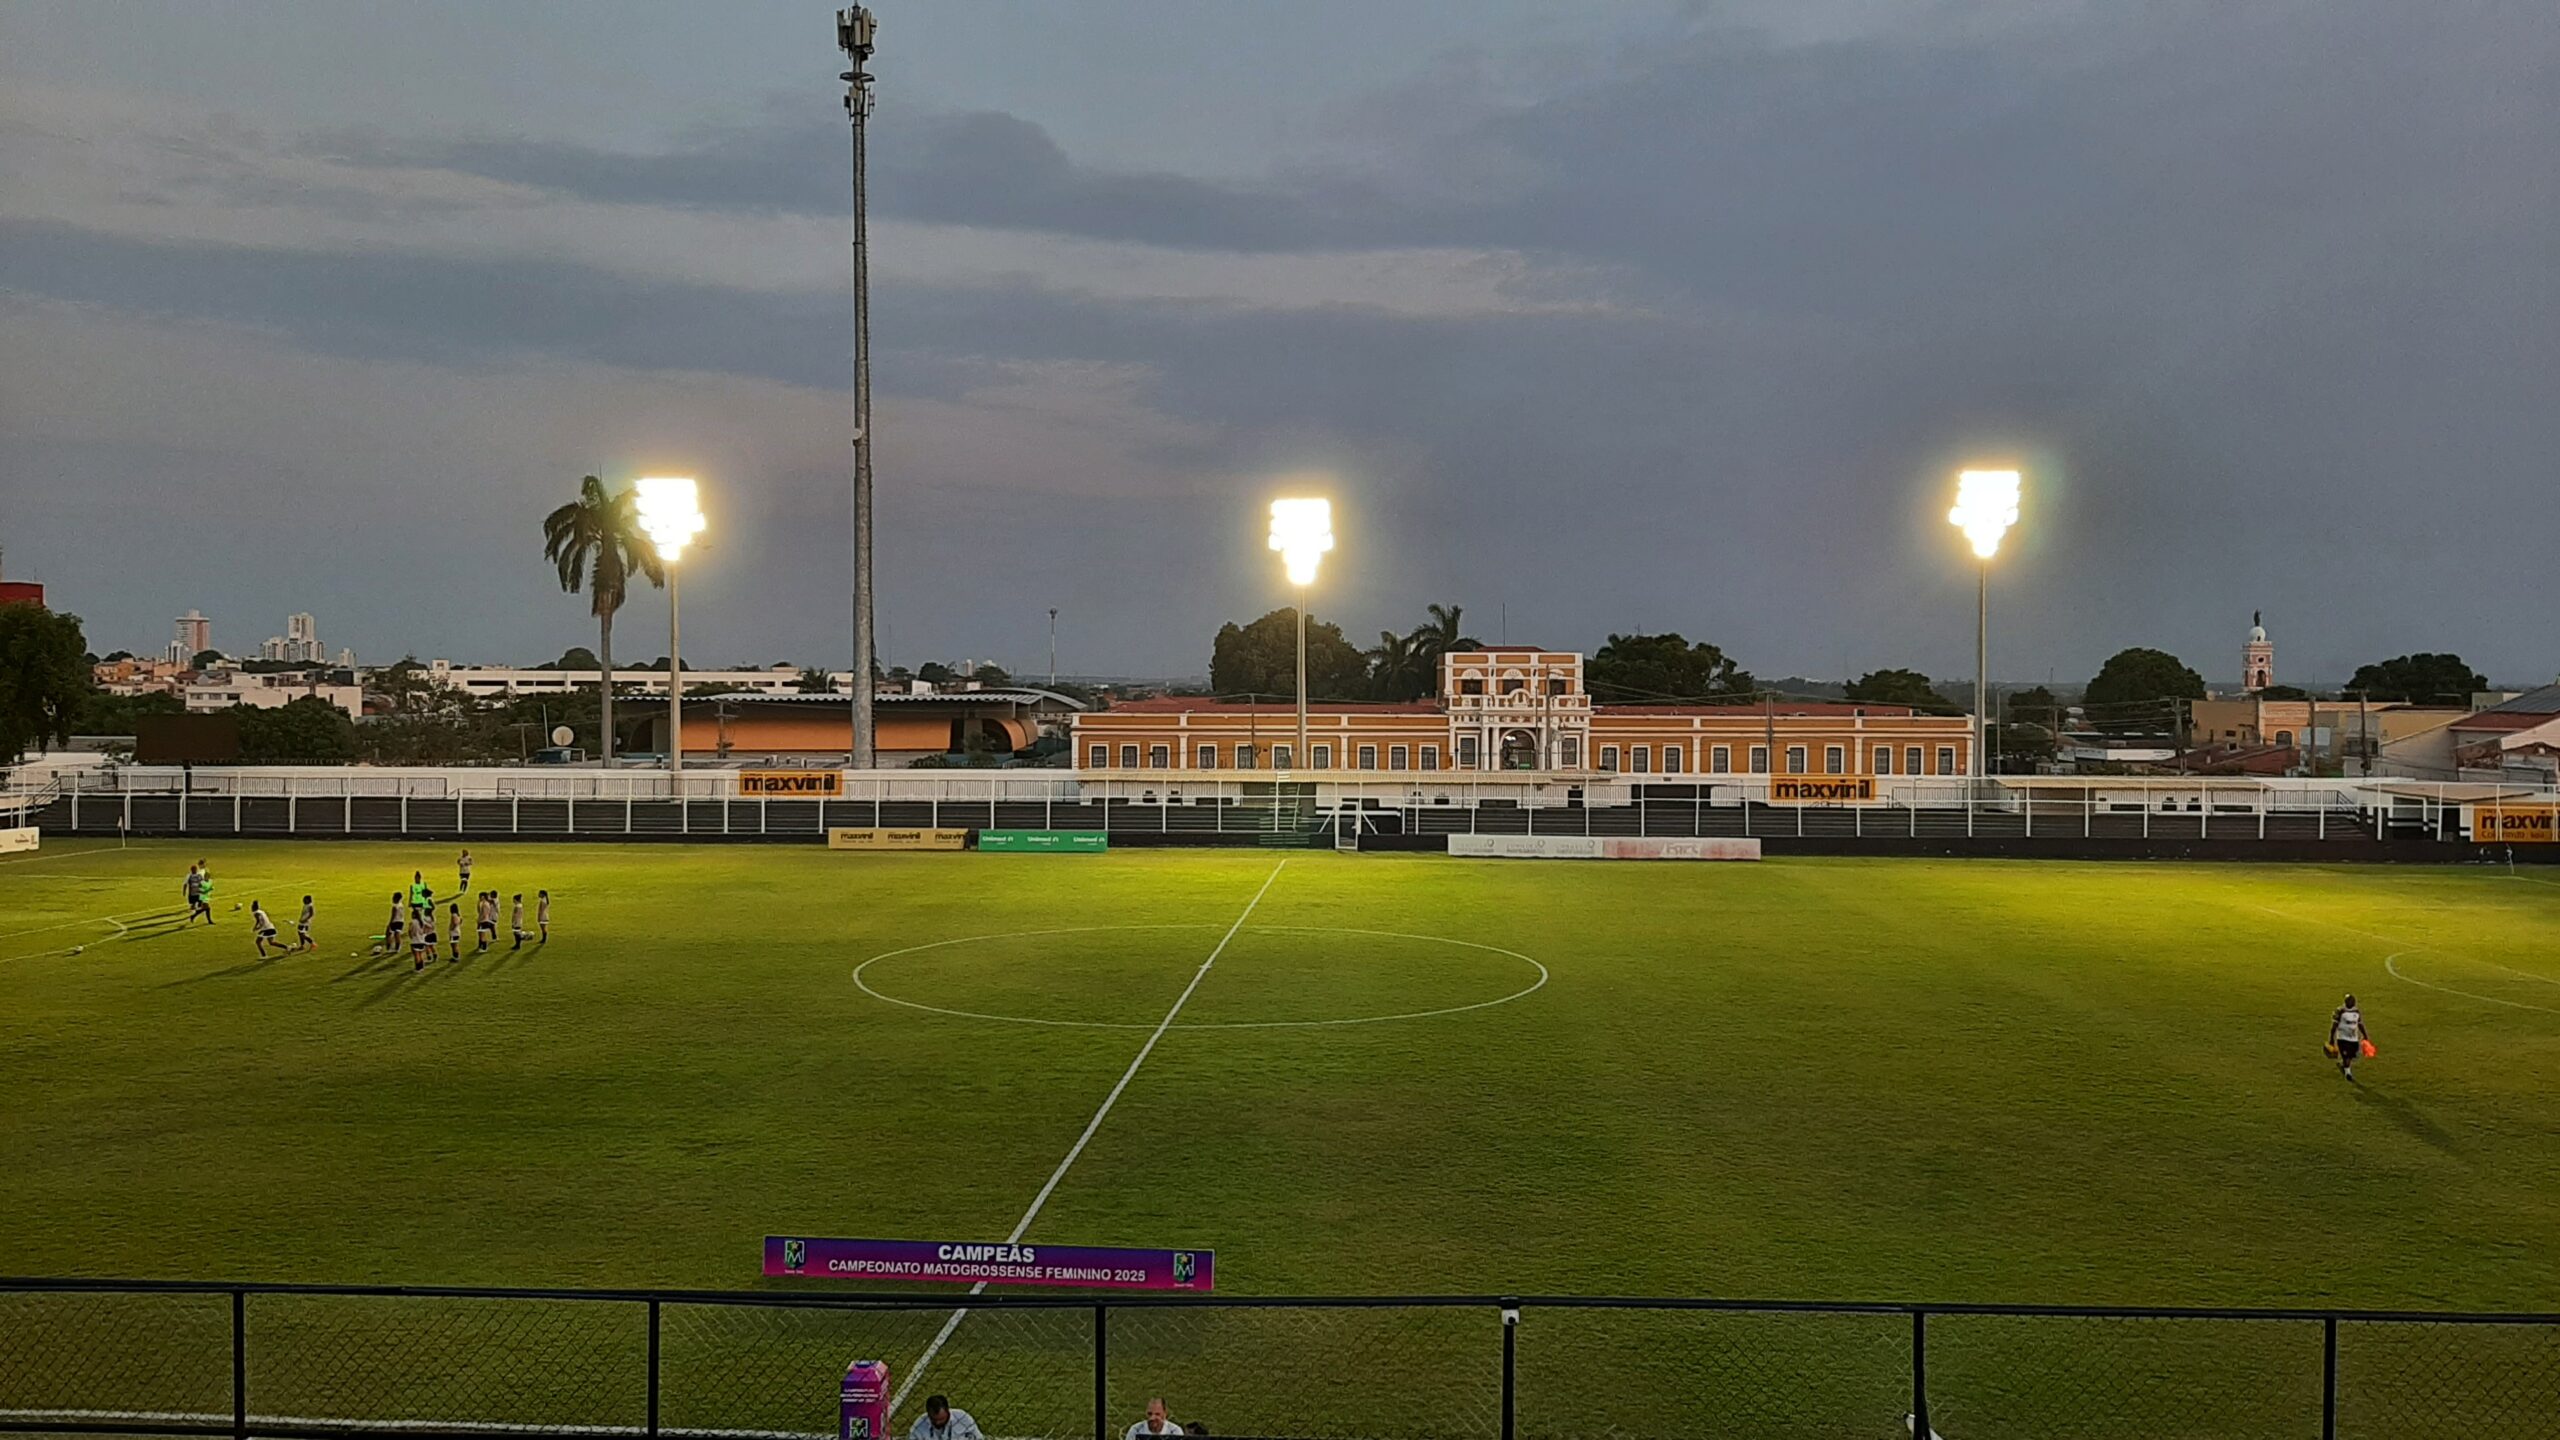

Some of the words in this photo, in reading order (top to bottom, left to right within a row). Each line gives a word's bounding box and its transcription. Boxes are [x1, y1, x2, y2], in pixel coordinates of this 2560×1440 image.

[744, 773, 835, 791] maxvinil
[1776, 779, 1870, 799] maxvinil
[938, 1244, 1035, 1263] CAMPEÃS
[828, 1259, 920, 1274] CAMPEONATO
[923, 1262, 1042, 1279] MATOGROSSENSE
[1045, 1267, 1112, 1281] FEMININO
[1114, 1269, 1146, 1282] 2025
